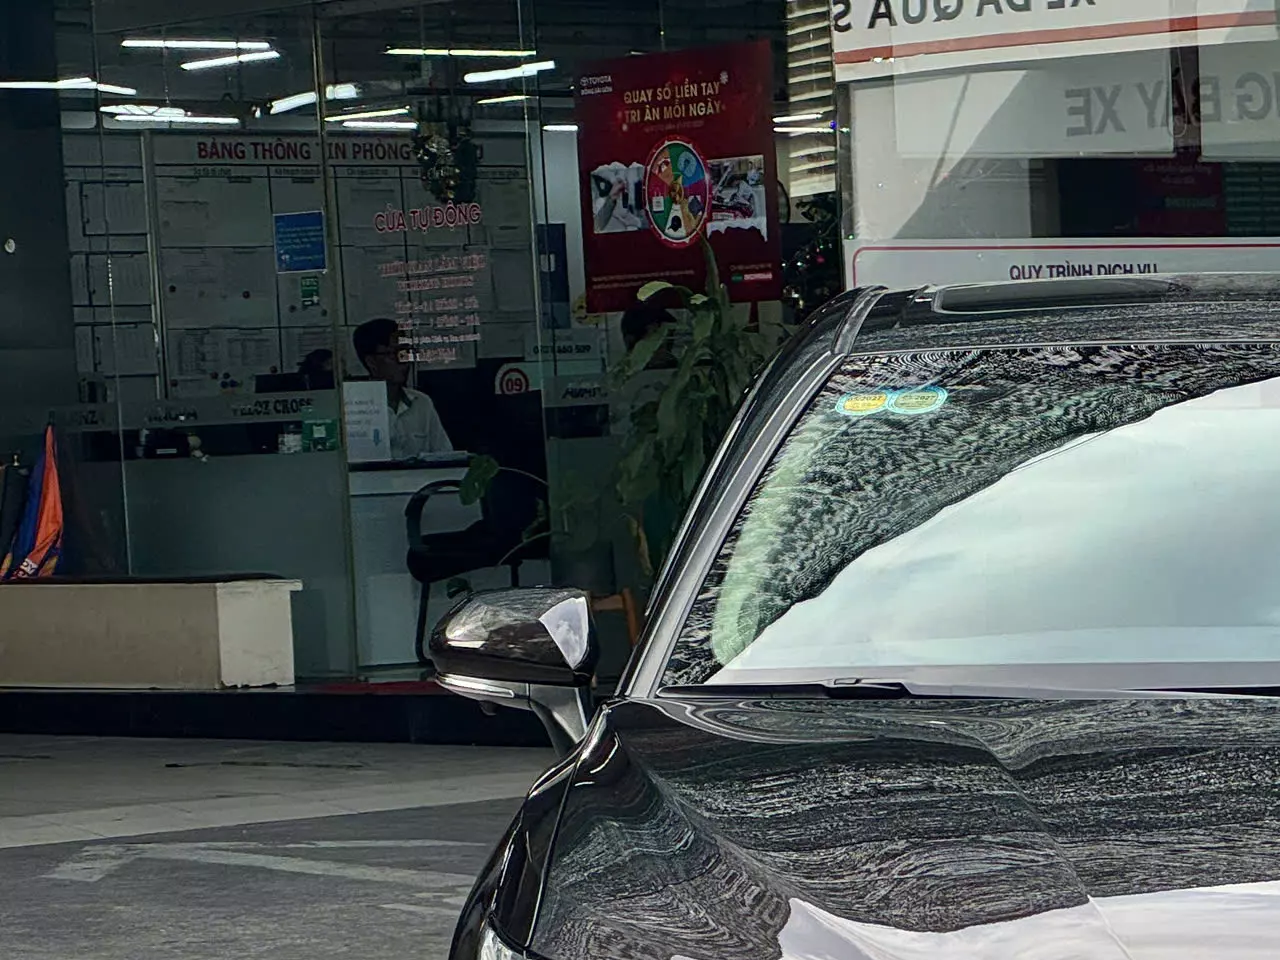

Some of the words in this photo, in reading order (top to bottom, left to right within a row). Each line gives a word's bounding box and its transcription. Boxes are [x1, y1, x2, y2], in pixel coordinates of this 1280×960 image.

[624, 88, 654, 105] QUAY
[656, 81, 672, 101] SỐ
[701, 81, 721, 95] TAY
[624, 109, 641, 124] TRI
[644, 104, 661, 121] ÂN
[689, 98, 722, 117] NGÀY
[197, 137, 246, 159] BẢNG
[250, 137, 311, 160] THÔNG
[352, 138, 411, 160] PHÒNG
[433, 200, 482, 231] ĐỘNG
[1010, 264, 1043, 281] QUY
[1046, 260, 1093, 278] TRÌNH
[506, 378, 523, 392] 09
